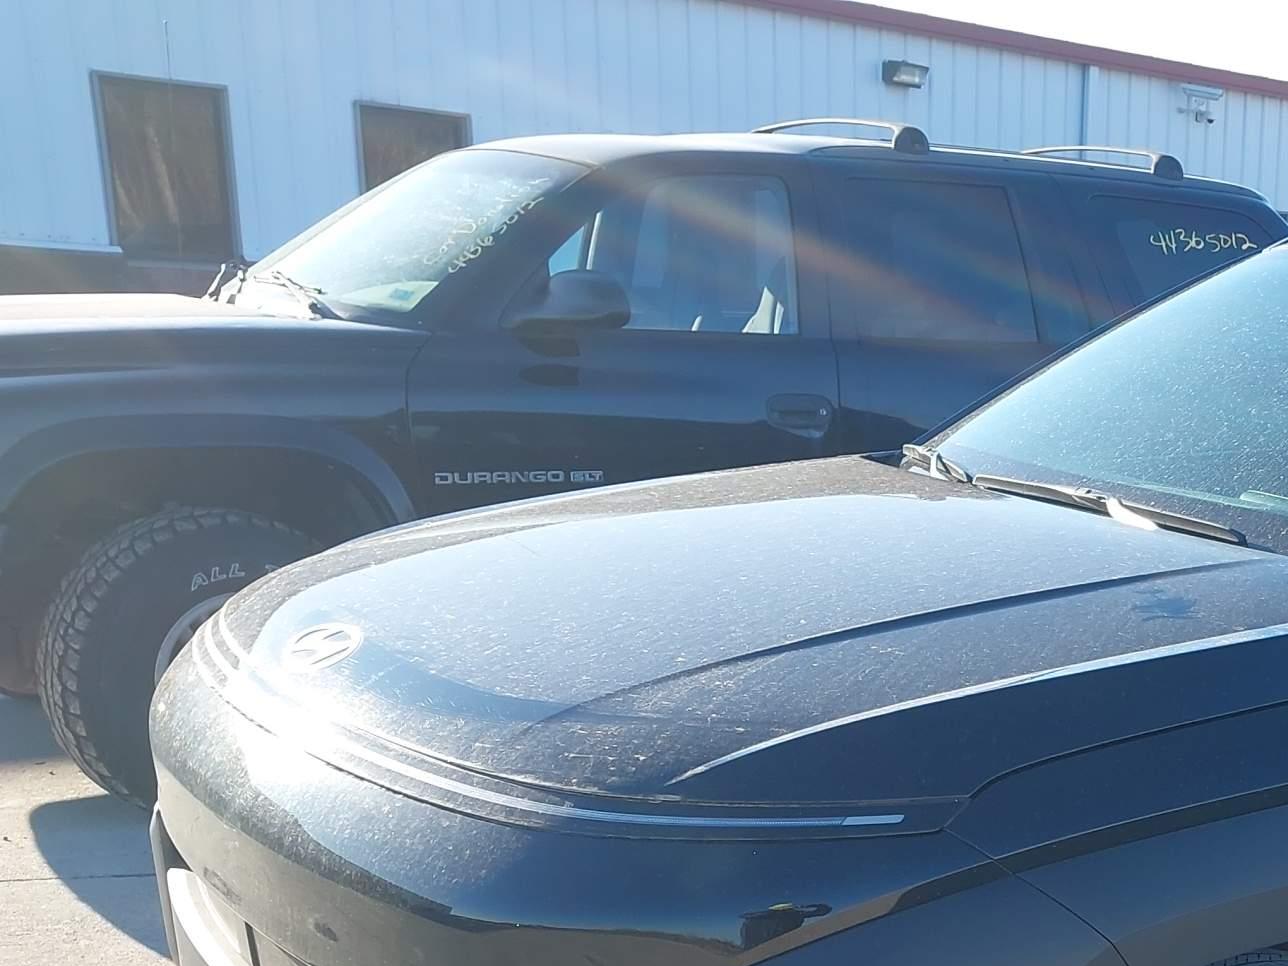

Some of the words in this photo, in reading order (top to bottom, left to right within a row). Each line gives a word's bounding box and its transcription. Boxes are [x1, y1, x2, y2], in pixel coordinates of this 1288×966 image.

[1149, 228, 1258, 256] 44365012
[434, 470, 565, 485] DURANGO
[191, 563, 246, 591] ALL
